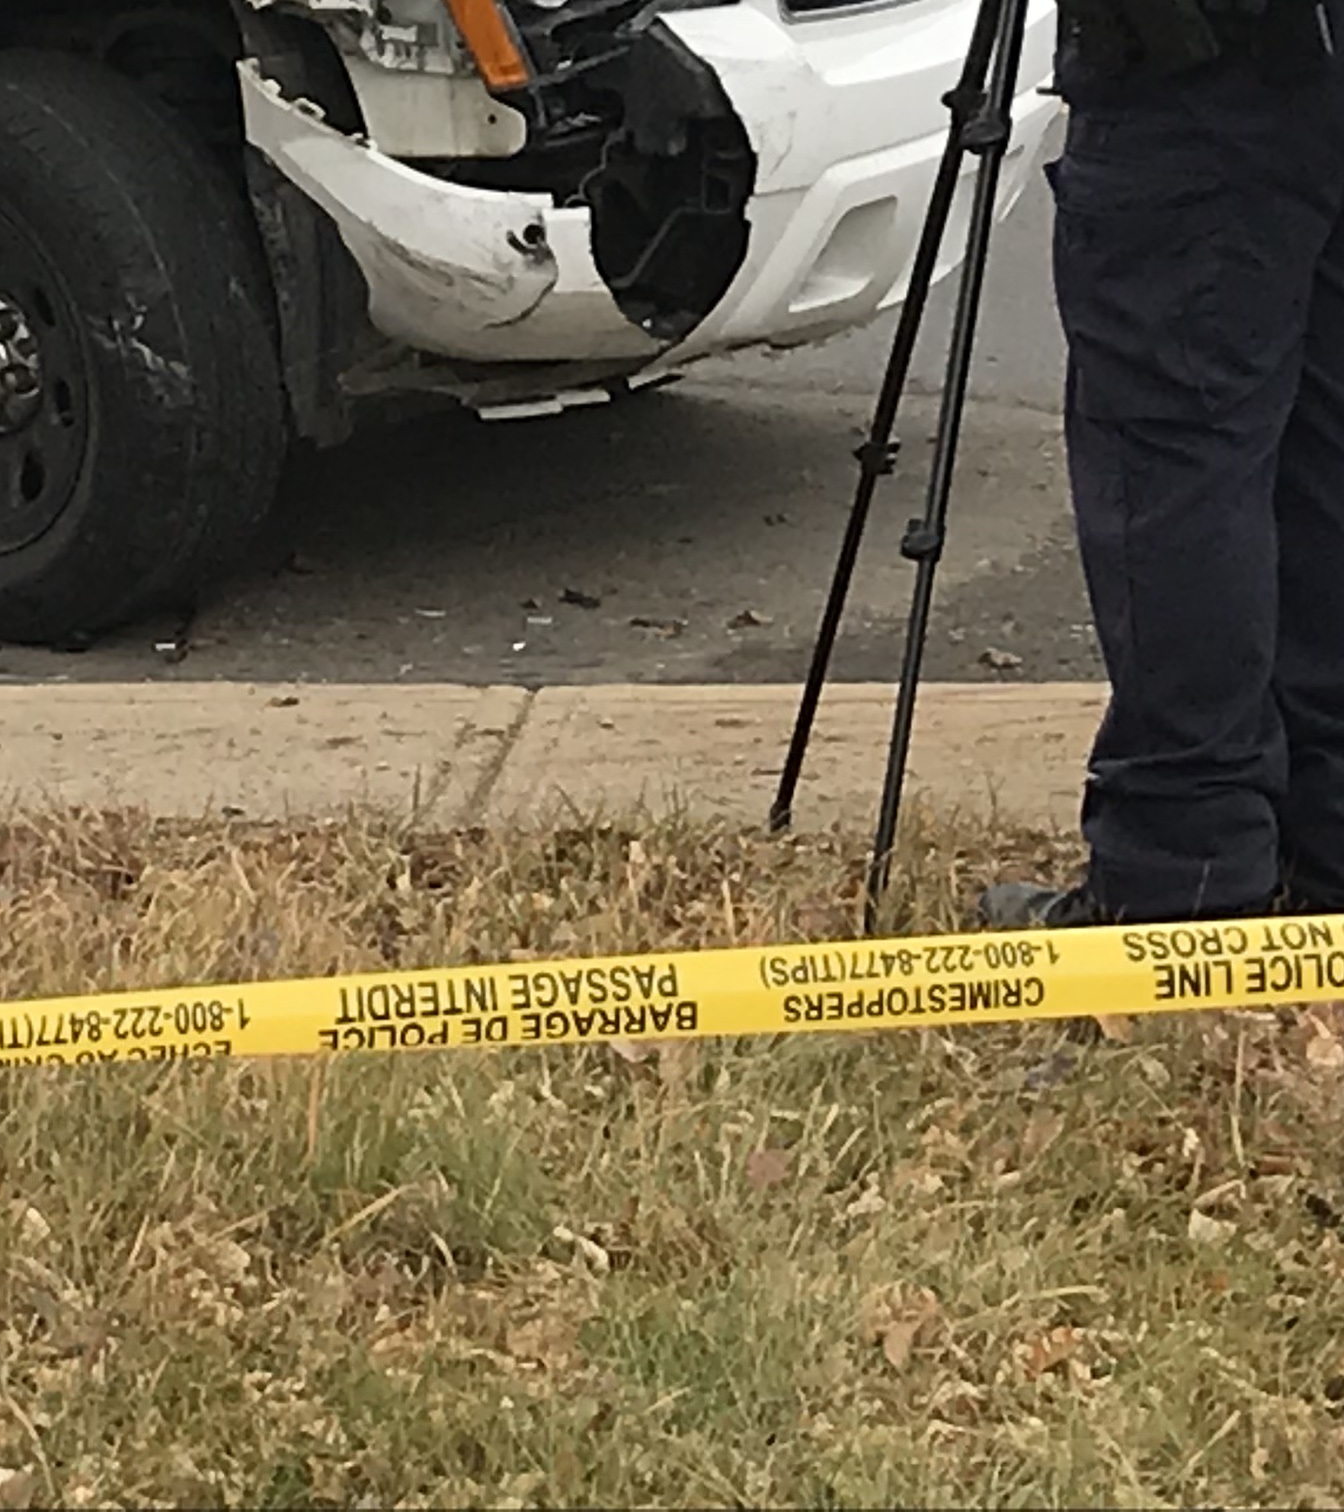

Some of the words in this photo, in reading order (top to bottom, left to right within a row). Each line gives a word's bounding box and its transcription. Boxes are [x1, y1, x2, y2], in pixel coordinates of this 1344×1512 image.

[1123, 927, 1249, 962] CROSS
[1262, 922, 1331, 952] NOT
[760, 940, 1060, 989] 1-800-222-8477(TIPS)
[1155, 957, 1233, 1000] LINE
[339, 977, 497, 1023] INTERDIT
[512, 964, 679, 1008] PASSAGE
[784, 976, 1045, 1023] CRIMESTOPPERS
[318, 1019, 449, 1051] POLICE
[462, 1016, 507, 1044] DE
[520, 1000, 698, 1040] BARRAGE
